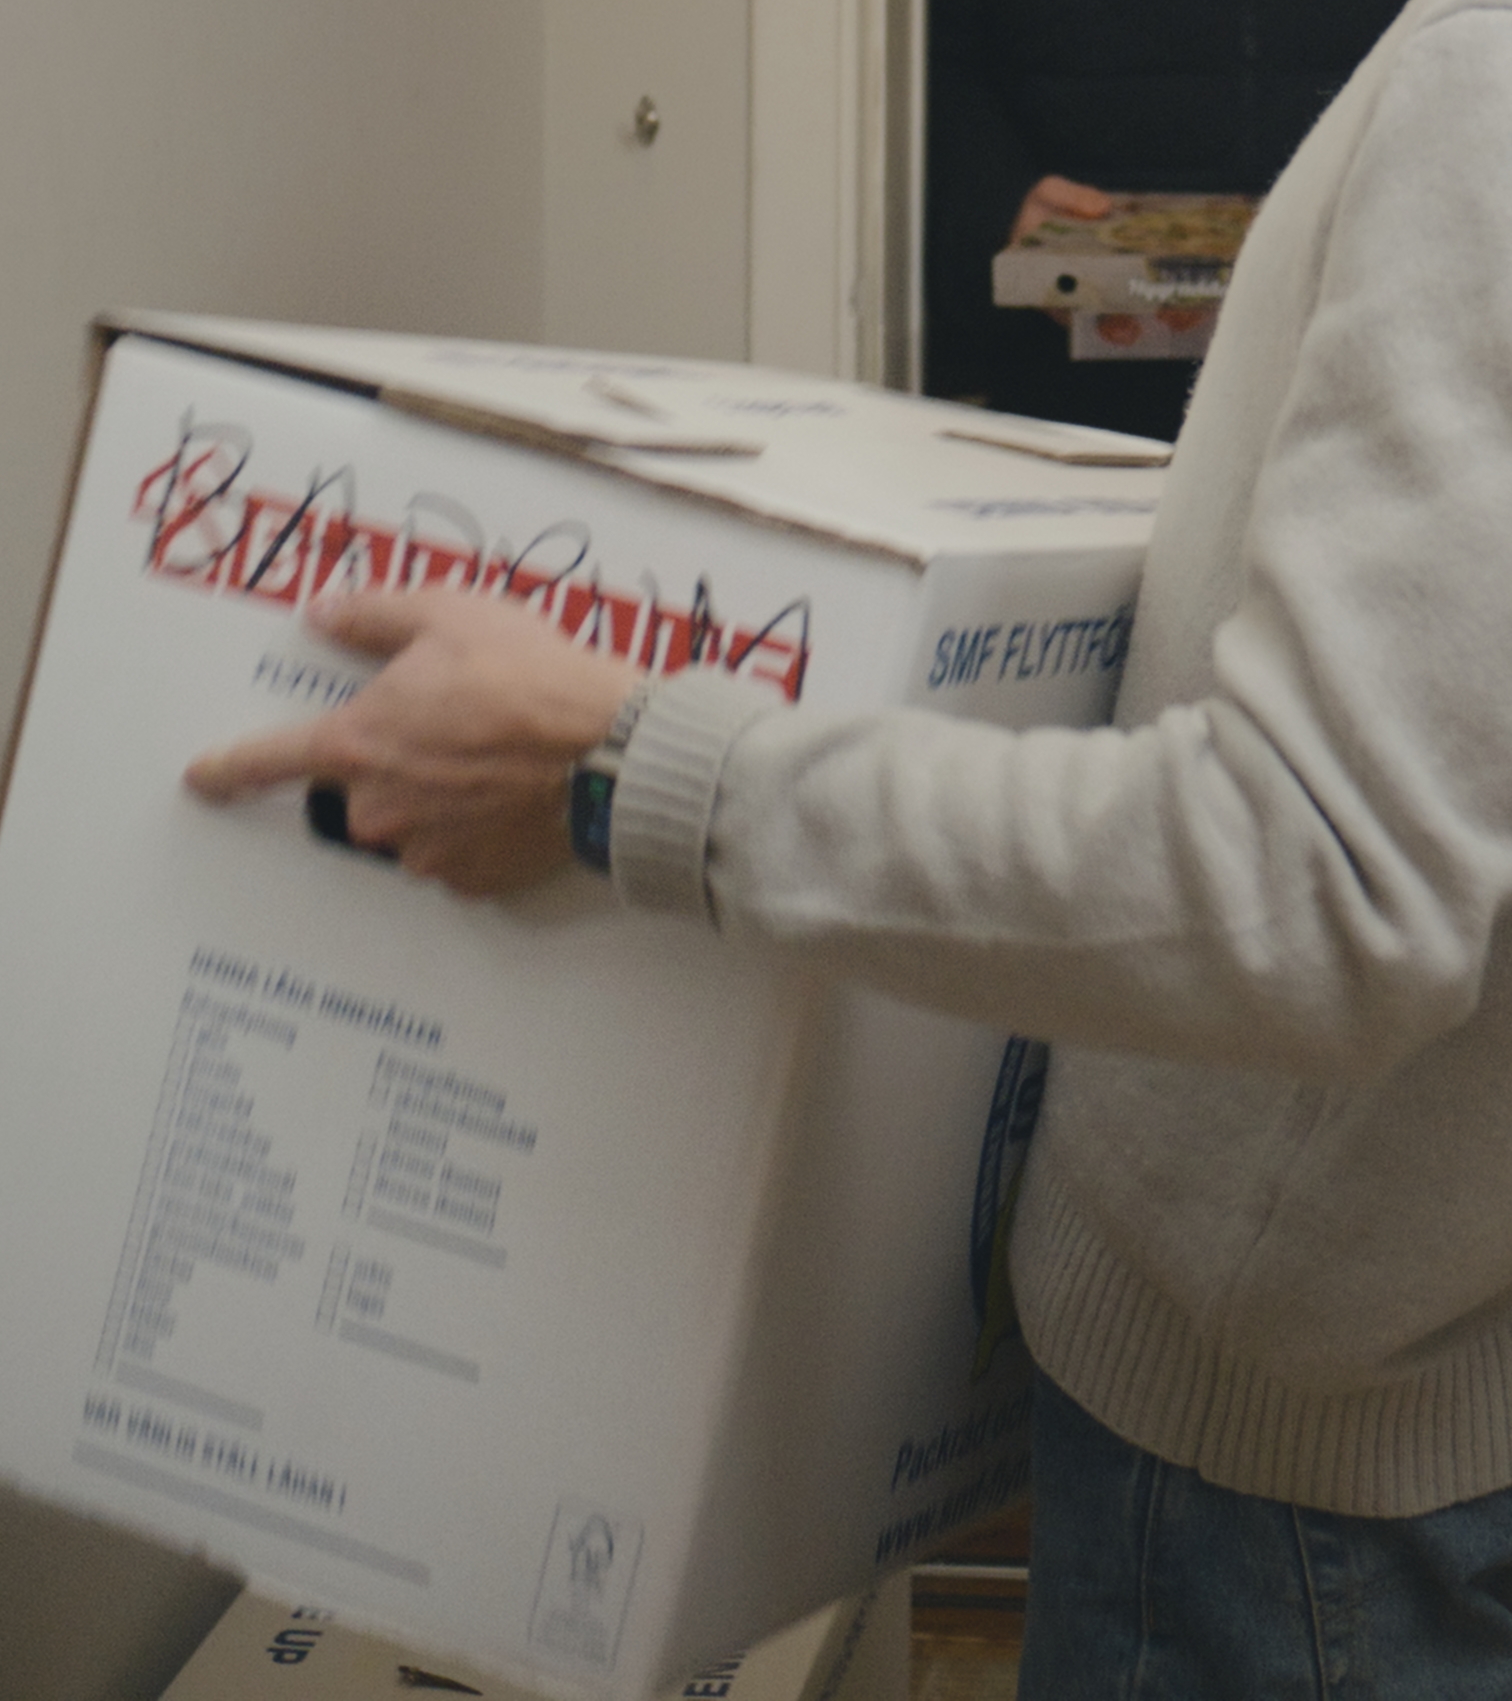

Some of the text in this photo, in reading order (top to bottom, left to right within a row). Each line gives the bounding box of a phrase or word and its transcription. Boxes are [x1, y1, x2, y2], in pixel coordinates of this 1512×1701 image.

[928, 604, 1133, 690] SMF FLYTTFÖ
[266, 1629, 323, 1665] UP
